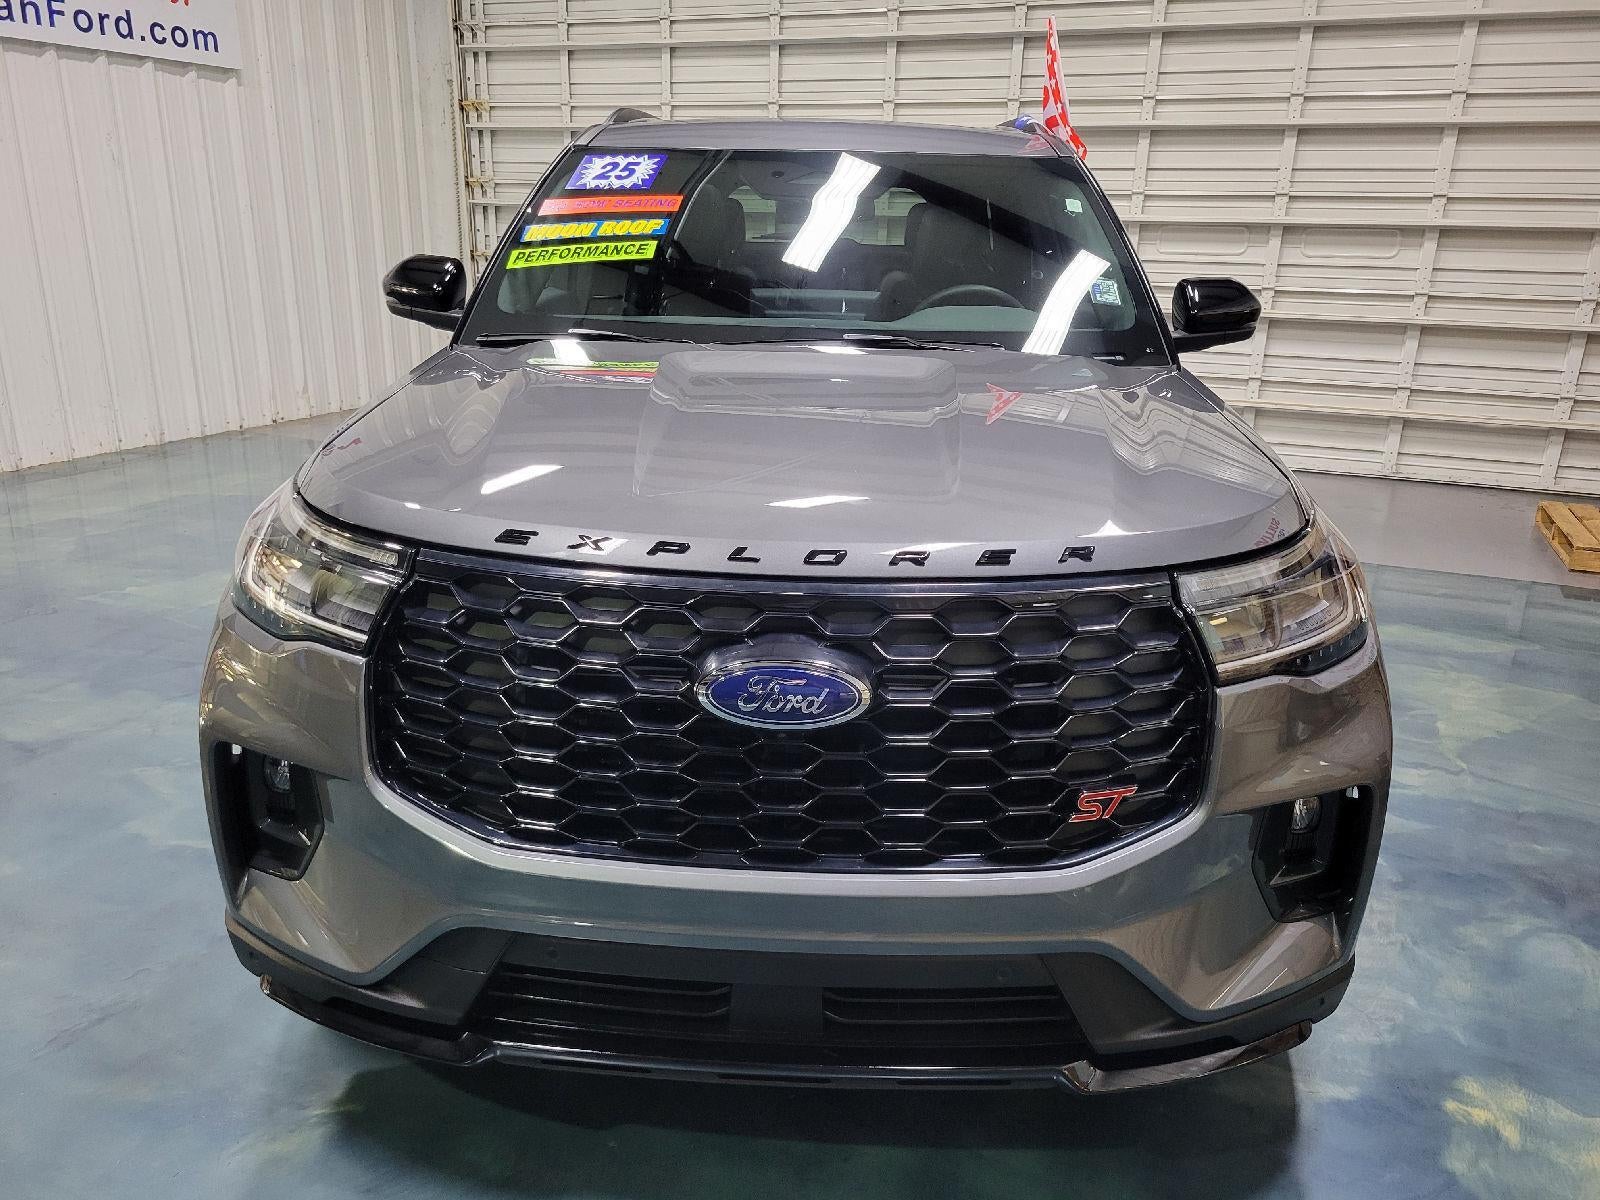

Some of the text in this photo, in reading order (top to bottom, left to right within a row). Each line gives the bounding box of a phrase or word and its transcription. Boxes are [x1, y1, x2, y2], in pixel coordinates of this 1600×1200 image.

[592, 161, 642, 181] 25
[612, 199, 679, 209] SEATING
[525, 219, 664, 241] MOON ROOF
[513, 243, 649, 265] PERFORMANCE
[493, 527, 1097, 567] EXPLORER
[738, 675, 830, 715] Ford
[1068, 784, 1139, 823] ST
